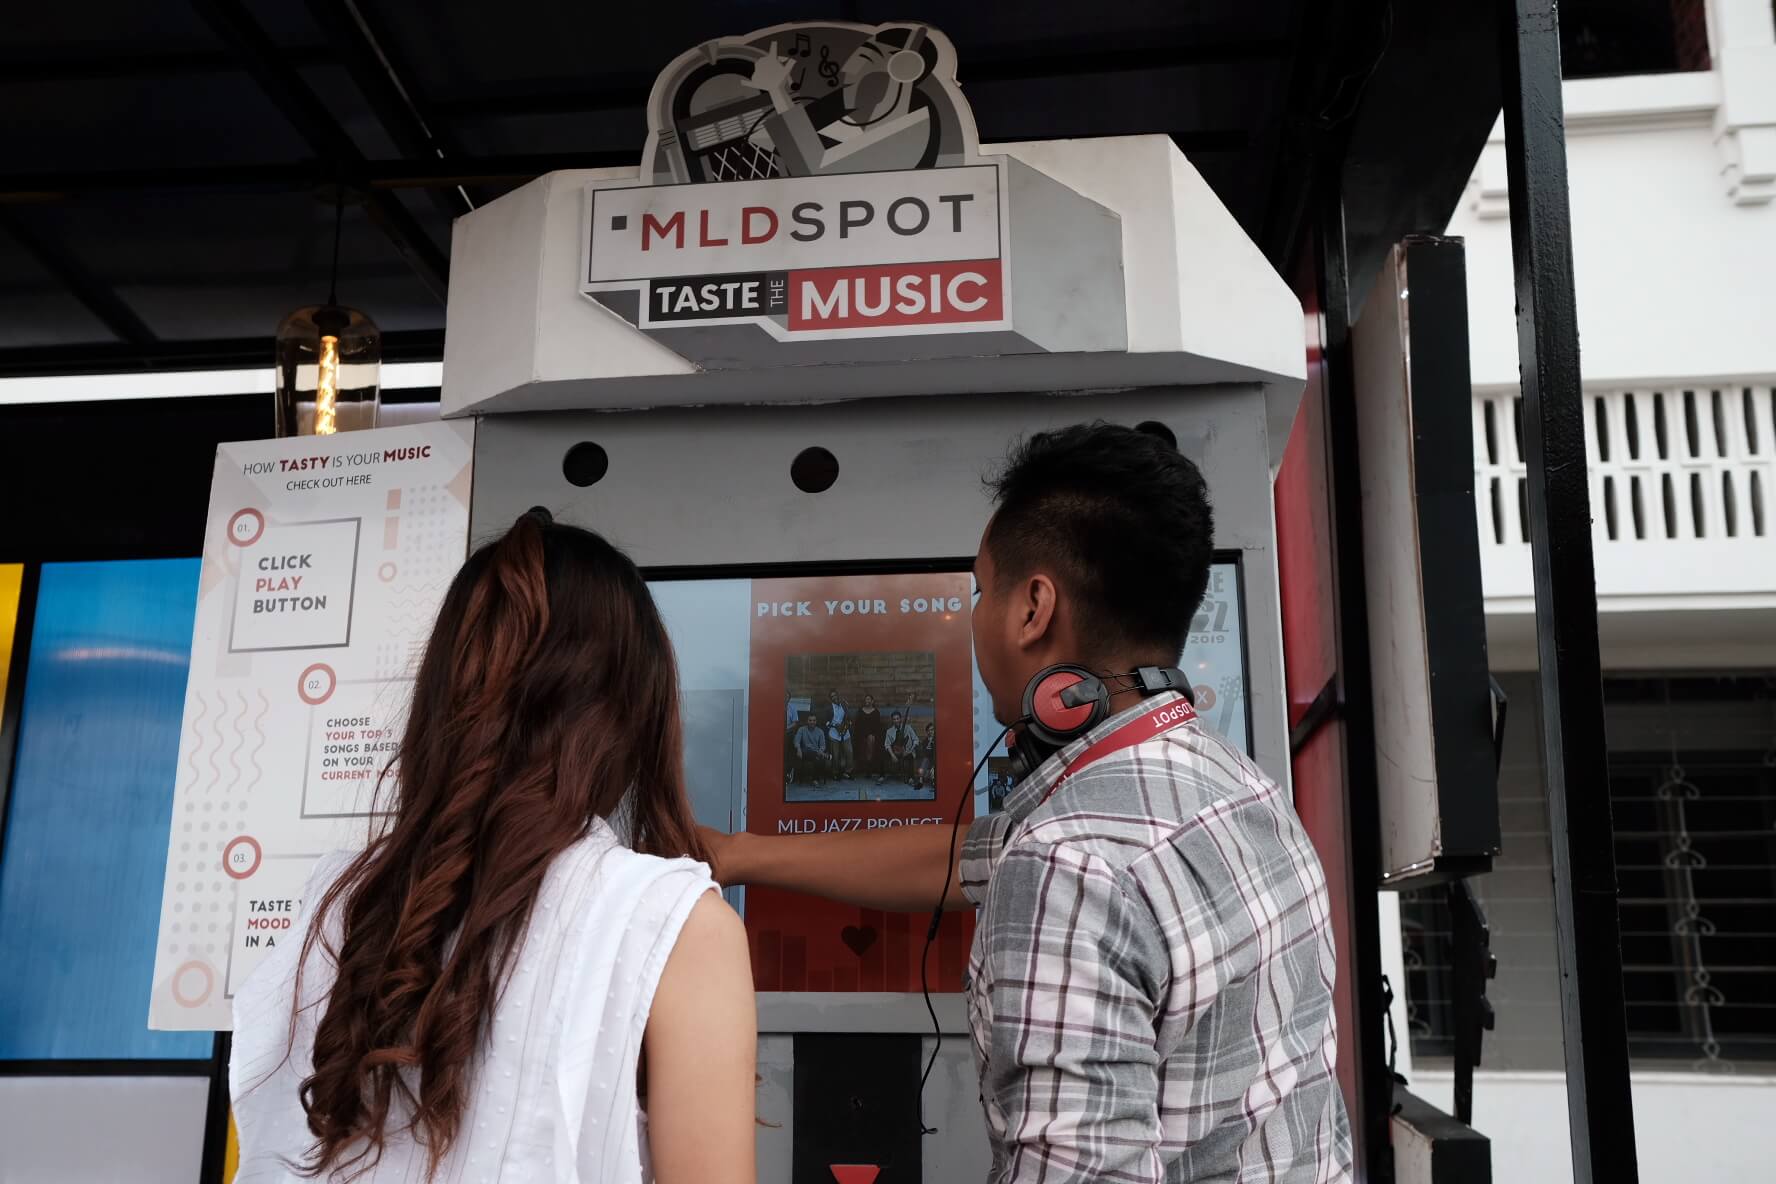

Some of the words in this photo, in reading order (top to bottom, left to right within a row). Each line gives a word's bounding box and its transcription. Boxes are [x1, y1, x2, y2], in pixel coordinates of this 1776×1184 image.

[640, 194, 974, 251] MLDSPOT
[656, 281, 760, 314] TASTE
[770, 279, 784, 307] THE
[800, 272, 989, 320] MUSIC
[243, 461, 275, 475] HOW
[279, 456, 330, 472] TASTY
[332, 455, 343, 468] IS
[346, 452, 380, 466] YOUR
[383, 445, 432, 463] MUSIC
[286, 478, 320, 491] CHECK
[322, 476, 344, 489] OUT
[346, 474, 372, 486] HERE
[258, 554, 312, 571] CLICK
[255, 576, 303, 592] PLAY
[253, 595, 327, 613] BUTTON
[757, 601, 812, 617] PICK
[825, 599, 887, 615] YOUR
[899, 597, 962, 613] SONG
[1190, 635, 1225, 644] 2019
[326, 717, 370, 728] CHOOSE
[326, 731, 355, 741] YOUR
[360, 730, 383, 740] TOP
[324, 743, 359, 754] SONGS
[364, 742, 399, 753] BASED
[322, 758, 338, 767] ON
[344, 756, 374, 766] YOUR
[321, 769, 372, 780] CURRENT
[778, 819, 816, 833] MLD
[820, 818, 861, 833] JAZZ
[249, 900, 292, 912] TASTE
[247, 918, 291, 930] MOOD
[245, 935, 260, 947] IN
[265, 935, 276, 947] A
